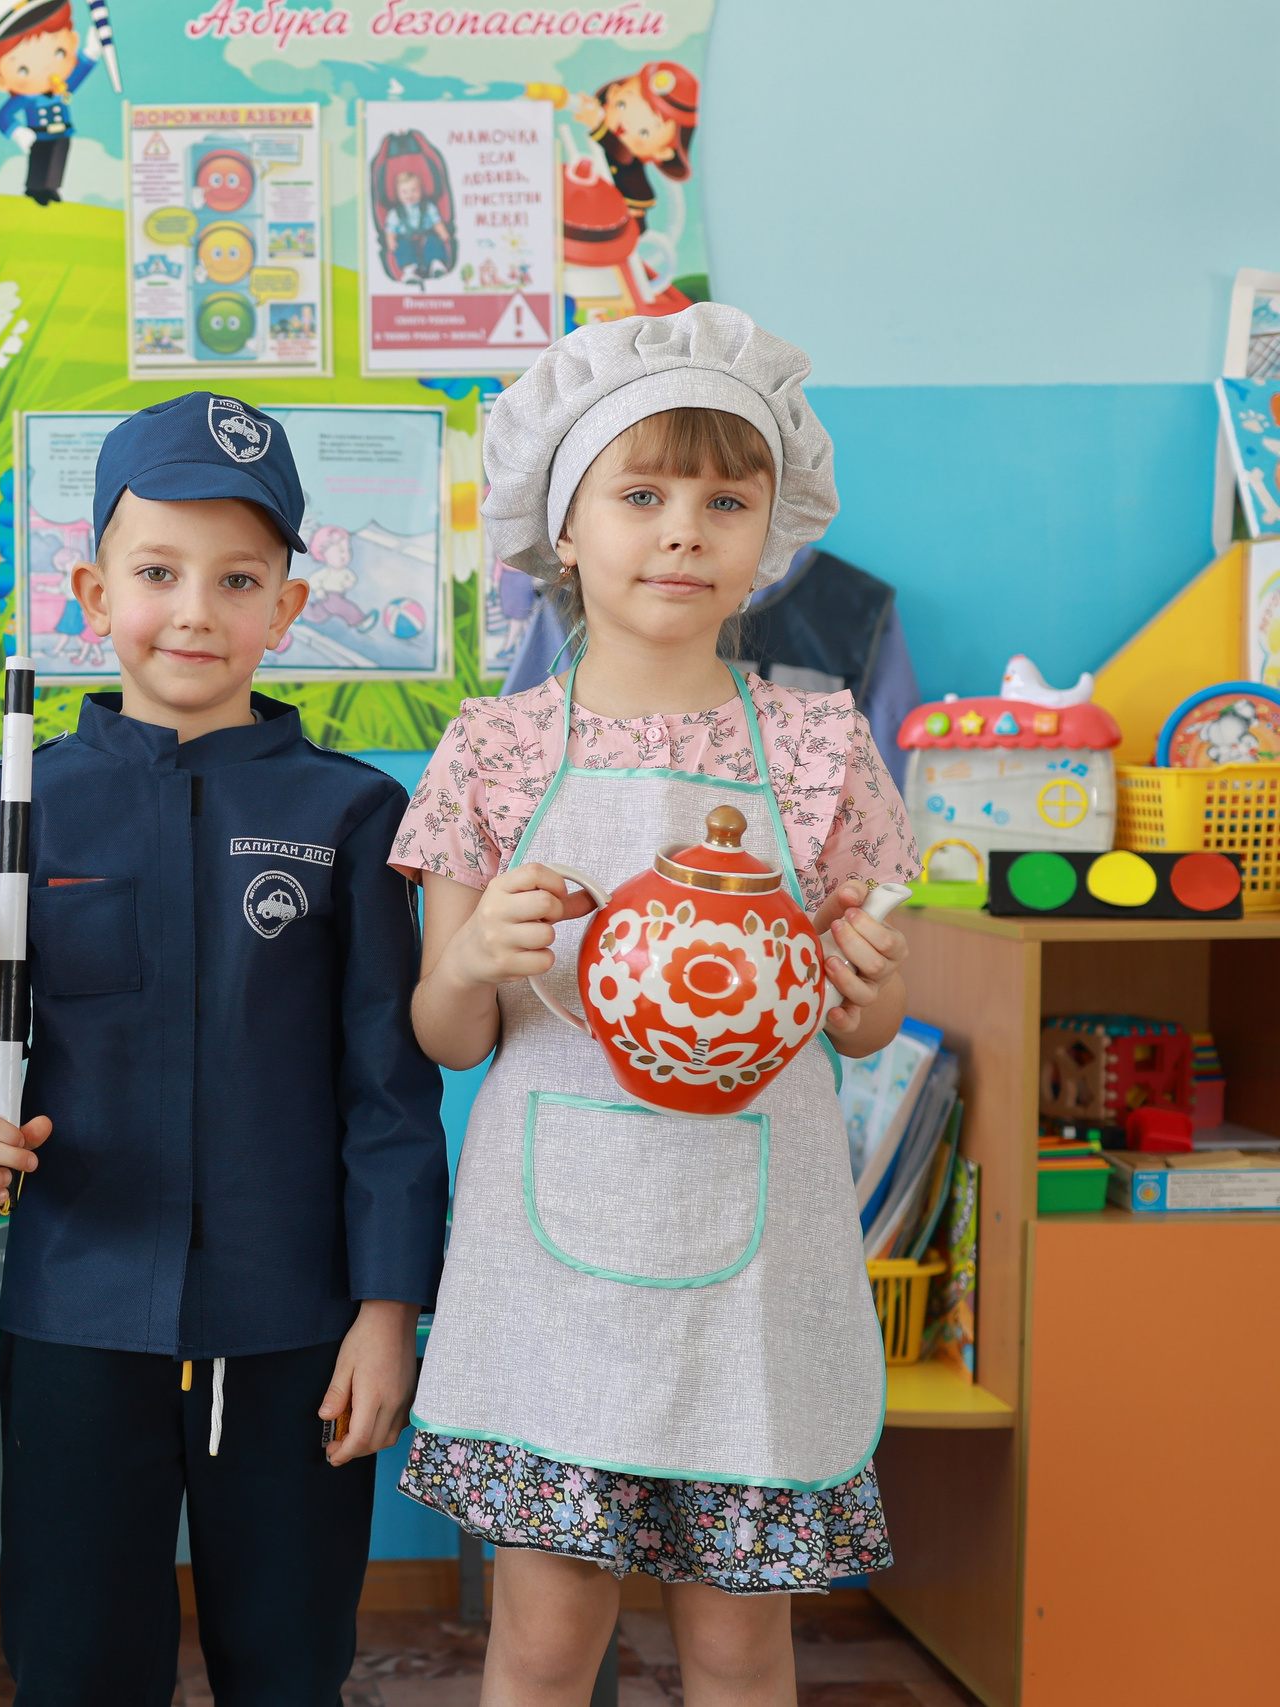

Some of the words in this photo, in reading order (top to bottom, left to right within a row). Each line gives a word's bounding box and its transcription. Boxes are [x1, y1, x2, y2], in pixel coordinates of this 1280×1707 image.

[187, 0, 349, 48] Азбука
[371, 1, 666, 37] безопасности
[133, 109, 240, 126] ДОРОЖНАЯ
[246, 108, 313, 123] АЗБУКА
[479, 151, 516, 165] ЕСЛИ
[462, 192, 542, 207] ПРИСТЕГНИ
[475, 210, 529, 227] МЕНЯ!
[945, 806, 956, 822] 3
[982, 802, 993, 816] 4
[234, 841, 299, 856] КАПИТАН
[302, 847, 331, 862] ДПС
